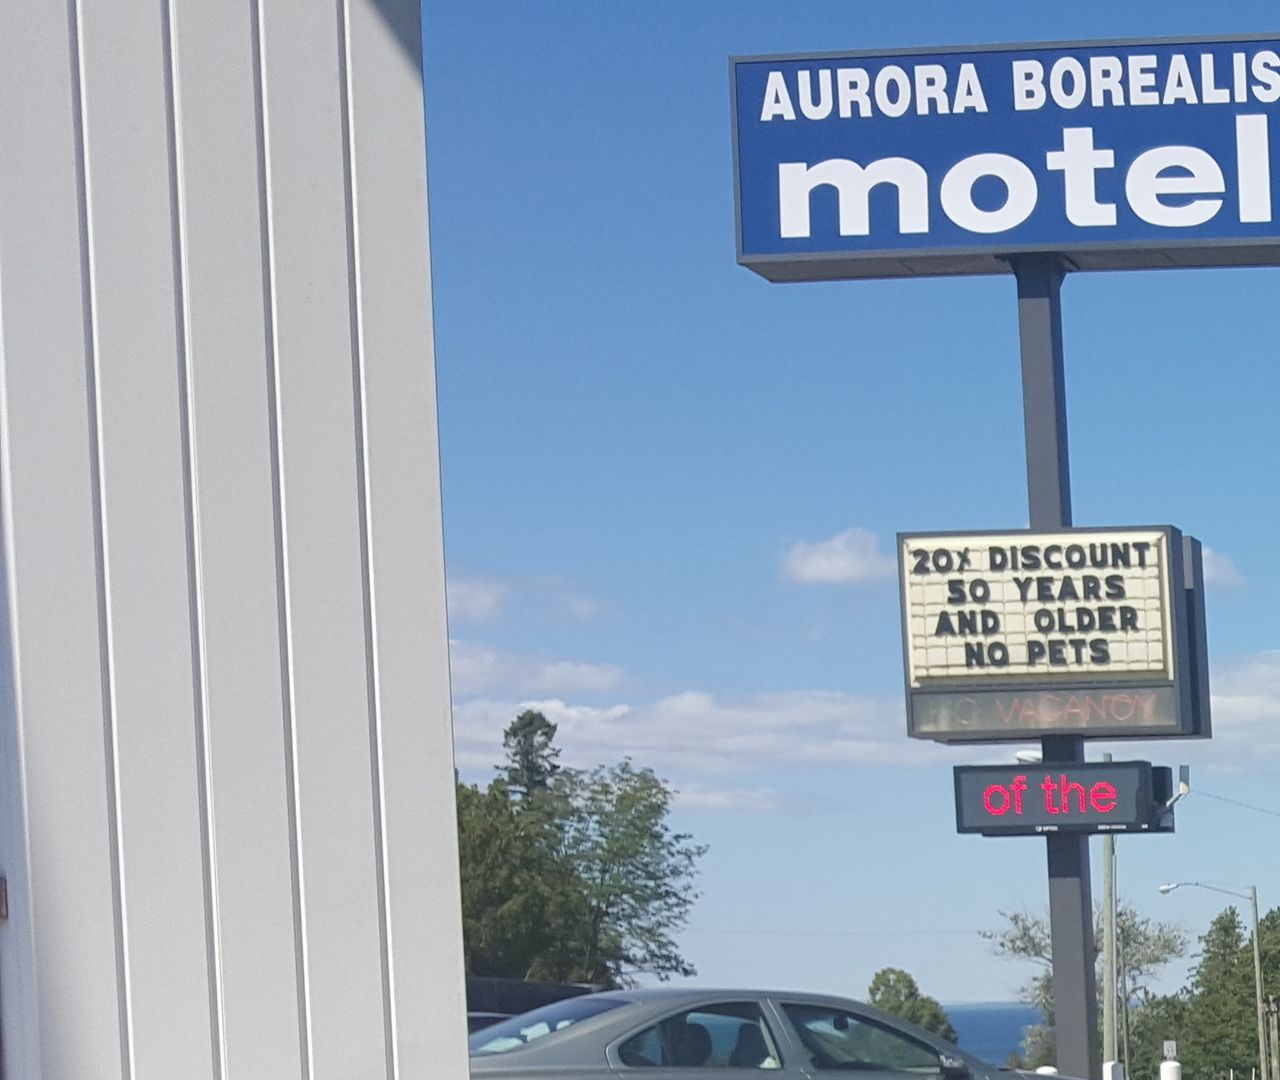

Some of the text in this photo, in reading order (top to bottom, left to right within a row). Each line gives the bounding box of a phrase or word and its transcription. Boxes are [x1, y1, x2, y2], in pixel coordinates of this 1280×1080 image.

[760, 63, 988, 121] AURORA
[779, 114, 1272, 238] motel
[989, 541, 1150, 572] DISCOUNT
[947, 574, 1126, 605] 50 YEARS
[935, 606, 1139, 637] AND OLDER
[965, 638, 1111, 667] NO PETS
[982, 774, 1118, 815] of the
